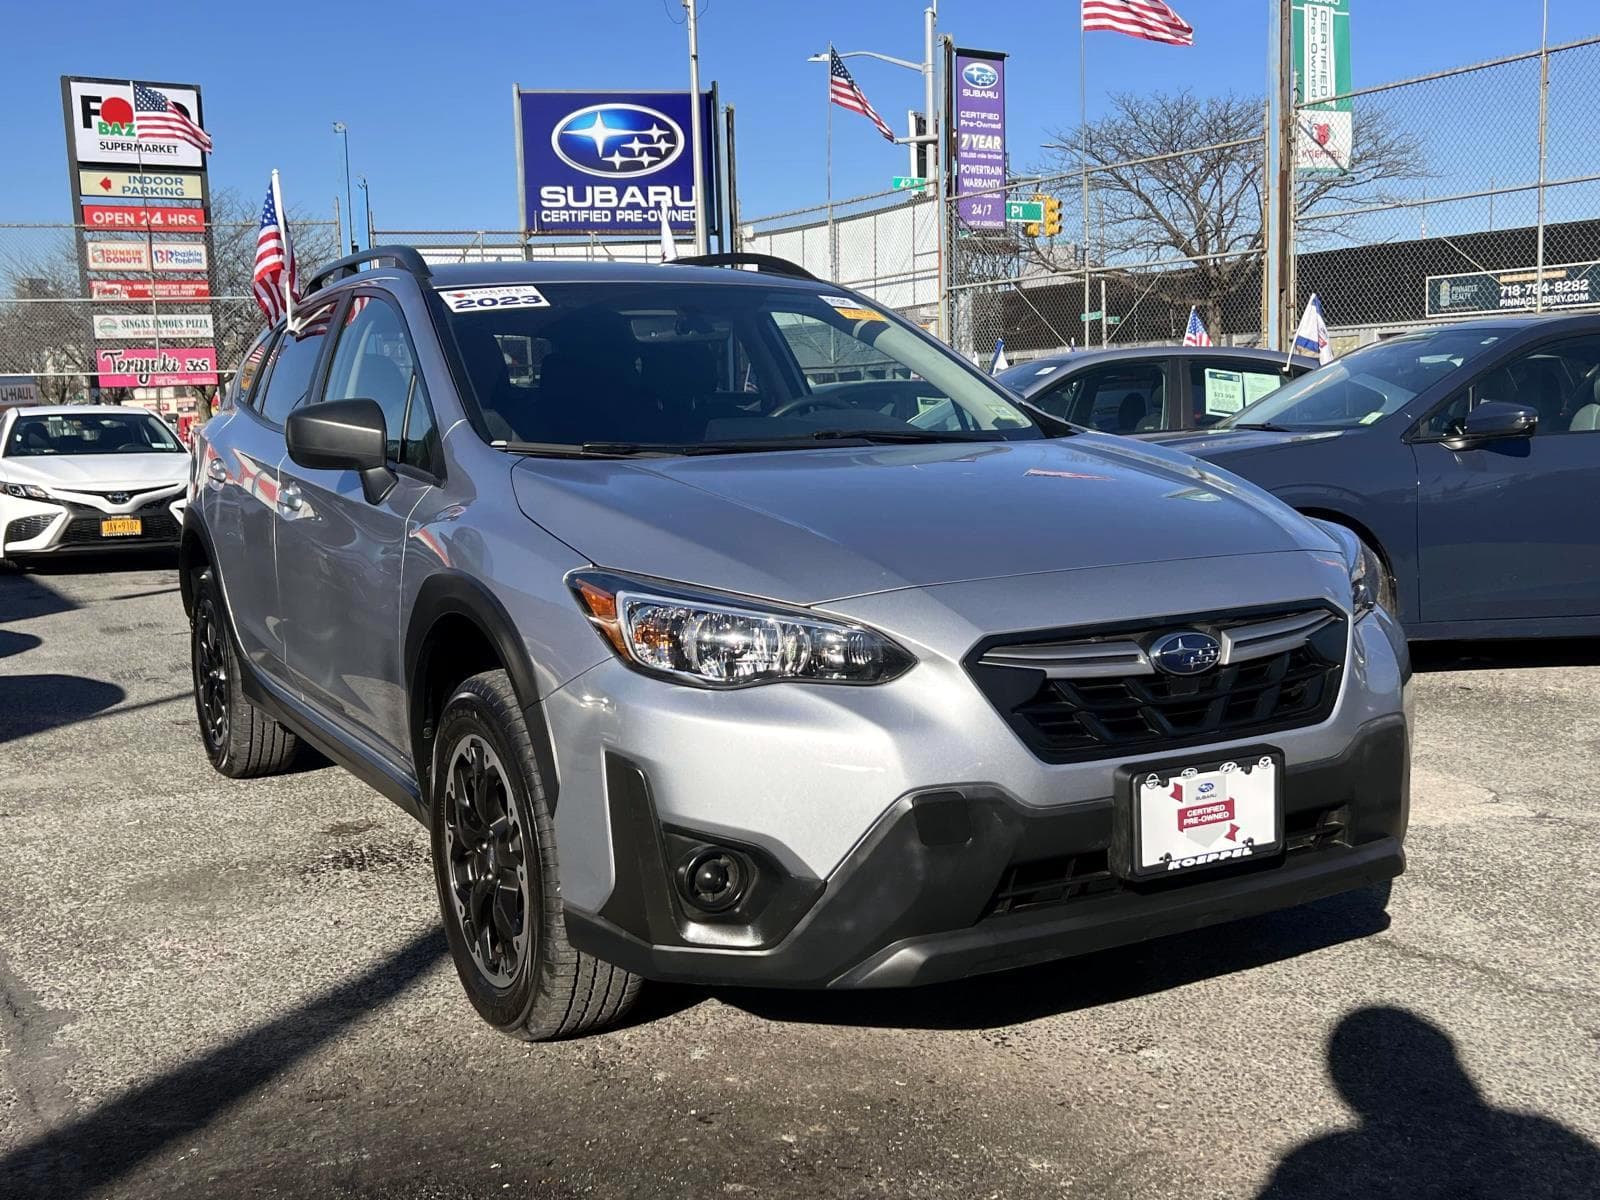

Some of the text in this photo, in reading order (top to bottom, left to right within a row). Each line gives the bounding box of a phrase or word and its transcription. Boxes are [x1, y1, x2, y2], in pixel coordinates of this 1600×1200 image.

[1310, 7, 1318, 98] Pre-Owned
[1320, 10, 1330, 96] CERTIFIED
[962, 89, 999, 99] SUBARU
[960, 111, 1000, 120] CERTIFIED
[960, 120, 1001, 129] Pre-Owned
[99, 141, 178, 154] SUPERMARKET
[961, 134, 1002, 150] 7 YEAR
[960, 165, 1002, 176] POWERTRAIN
[128, 175, 184, 186] INDOOR
[962, 177, 1001, 189] WARRANTY
[122, 186, 185, 197] PARKING
[540, 185, 696, 208] SUBARU
[971, 203, 992, 216] 24/7
[92, 211, 198, 225] OPEN 24 HRS
[541, 210, 697, 223] CERTIFIED PRE-OWNED
[105, 256, 143, 264] DONUTS
[154, 249, 174, 264] BR
[1500, 279, 1590, 297] 718-784-8282
[455, 295, 543, 309] 2023
[1500, 293, 1590, 307] PINNACLRENY.COM
[121, 319, 151, 329] SINGAS
[186, 319, 209, 328] PIZZA
[186, 359, 210, 372] 365
[1, 386, 34, 401] U-HAUL
[1195, 793, 1217, 801] SUBARU
[1187, 804, 1226, 817] CERTIFIED
[1183, 811, 1230, 826] PRE-OWNED
[1167, 847, 1253, 871] KOEPPEL
